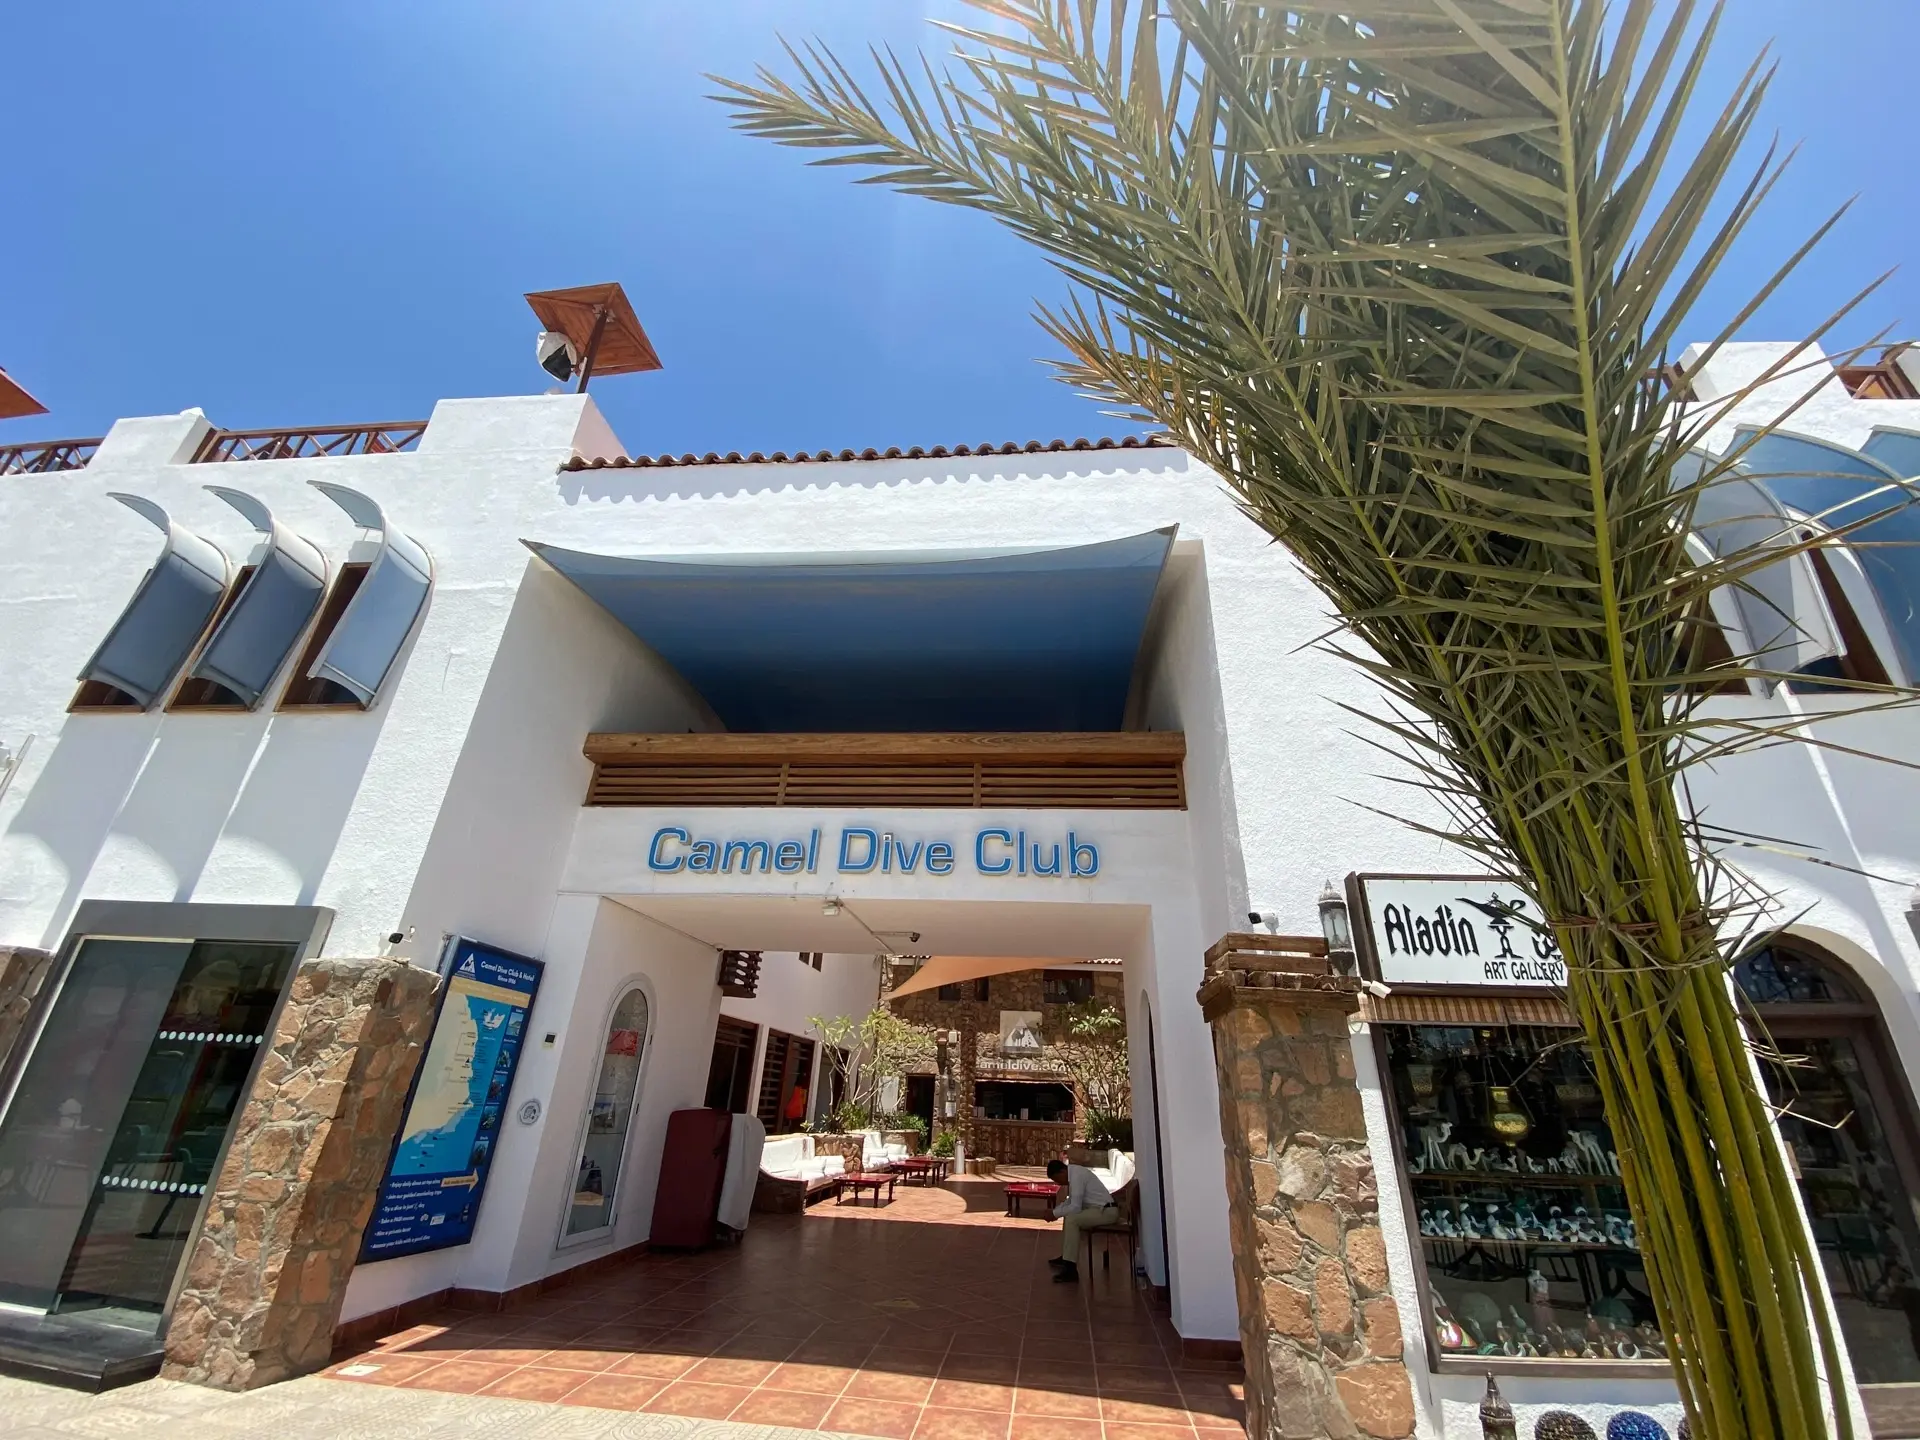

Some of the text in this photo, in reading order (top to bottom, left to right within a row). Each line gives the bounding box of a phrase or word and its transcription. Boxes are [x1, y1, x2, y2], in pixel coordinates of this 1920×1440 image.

[648, 826, 1100, 878] Camel Dive Club
[1384, 902, 1480, 956] Aladin
[481, 961, 498, 973] Camel
[498, 966, 508, 975] Dive
[508, 968, 519, 978] Club
[523, 973, 535, 982] Hotel
[1484, 961, 1564, 981] ART GALLERY
